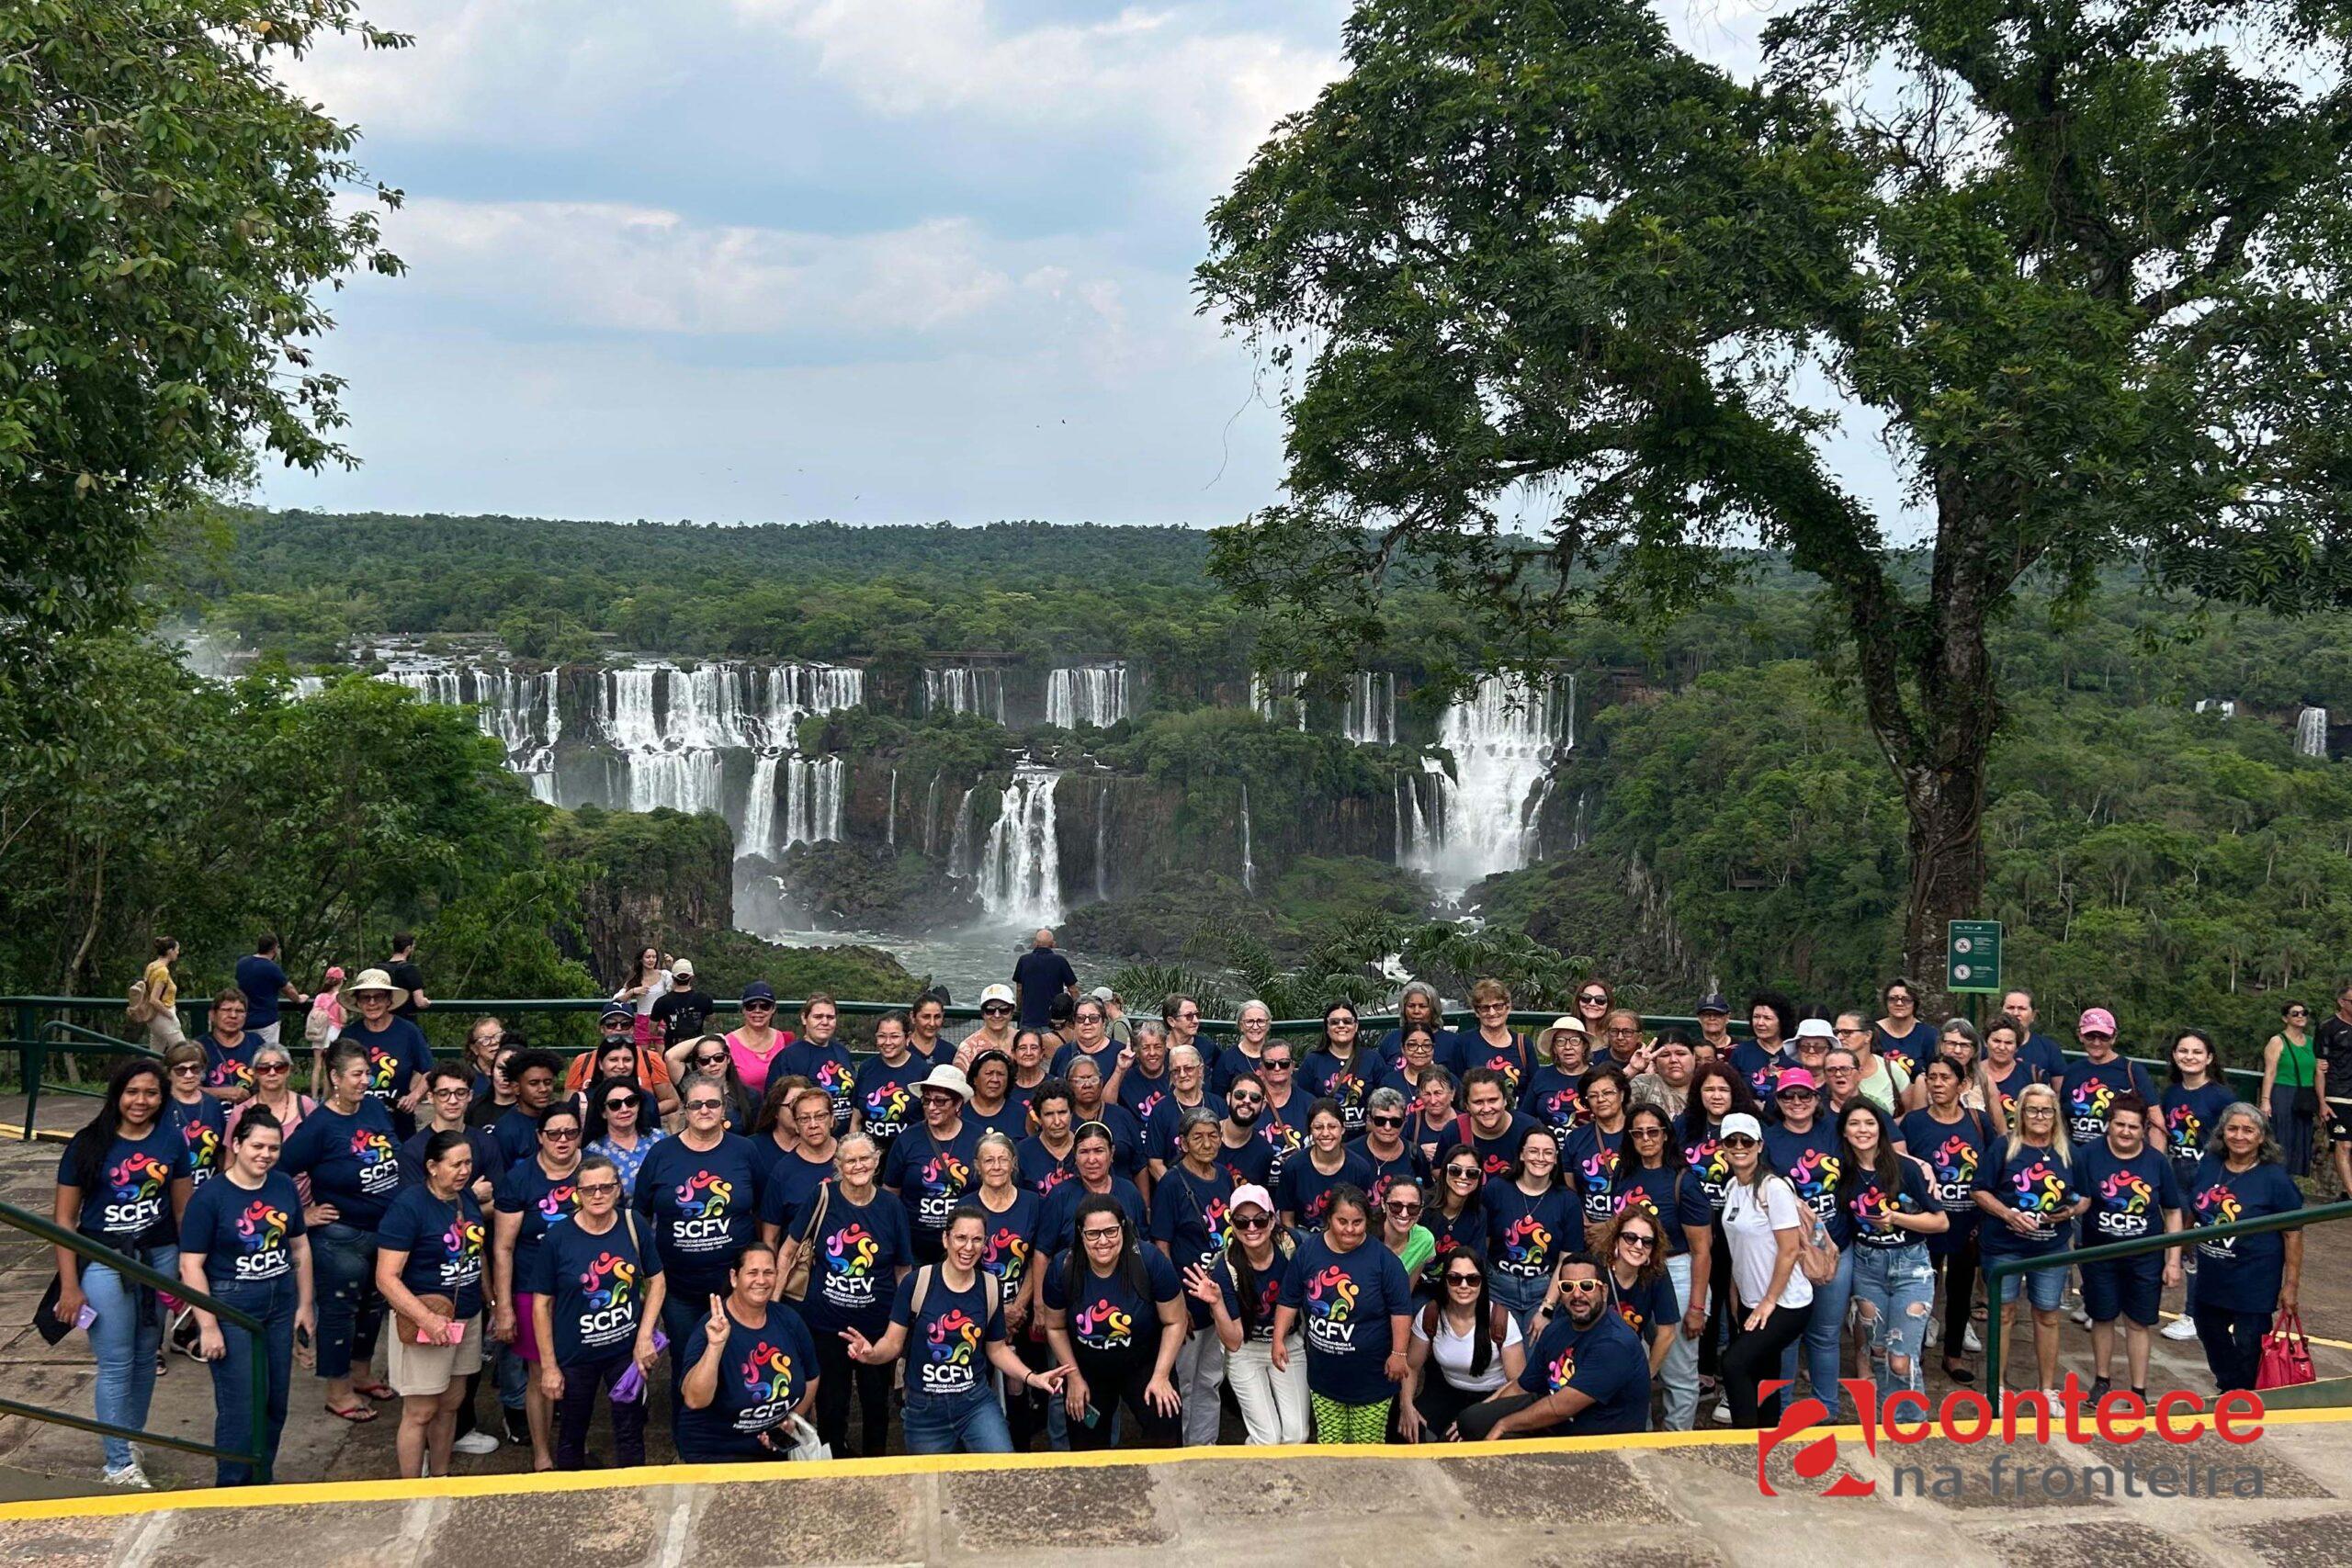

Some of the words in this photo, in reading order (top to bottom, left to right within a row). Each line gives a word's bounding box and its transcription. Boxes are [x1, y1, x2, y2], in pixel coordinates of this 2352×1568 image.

[865, 1121, 908, 1137] SCFV
[2071, 1118, 2109, 1133] SCFV
[192, 1167, 216, 1185] FV
[104, 1198, 162, 1222] SCFV
[920, 1198, 958, 1215] SCF
[673, 1217, 731, 1238] SCFV
[2098, 1212, 2148, 1230] SCFV
[235, 1249, 286, 1272] SCFV
[825, 1271, 875, 1293] SCFV
[580, 1301, 633, 1334] SCFV
[1308, 1314, 1355, 1342] SCFV
[922, 1363, 974, 1383] SCFV
[739, 1397, 800, 1418] SCFV
